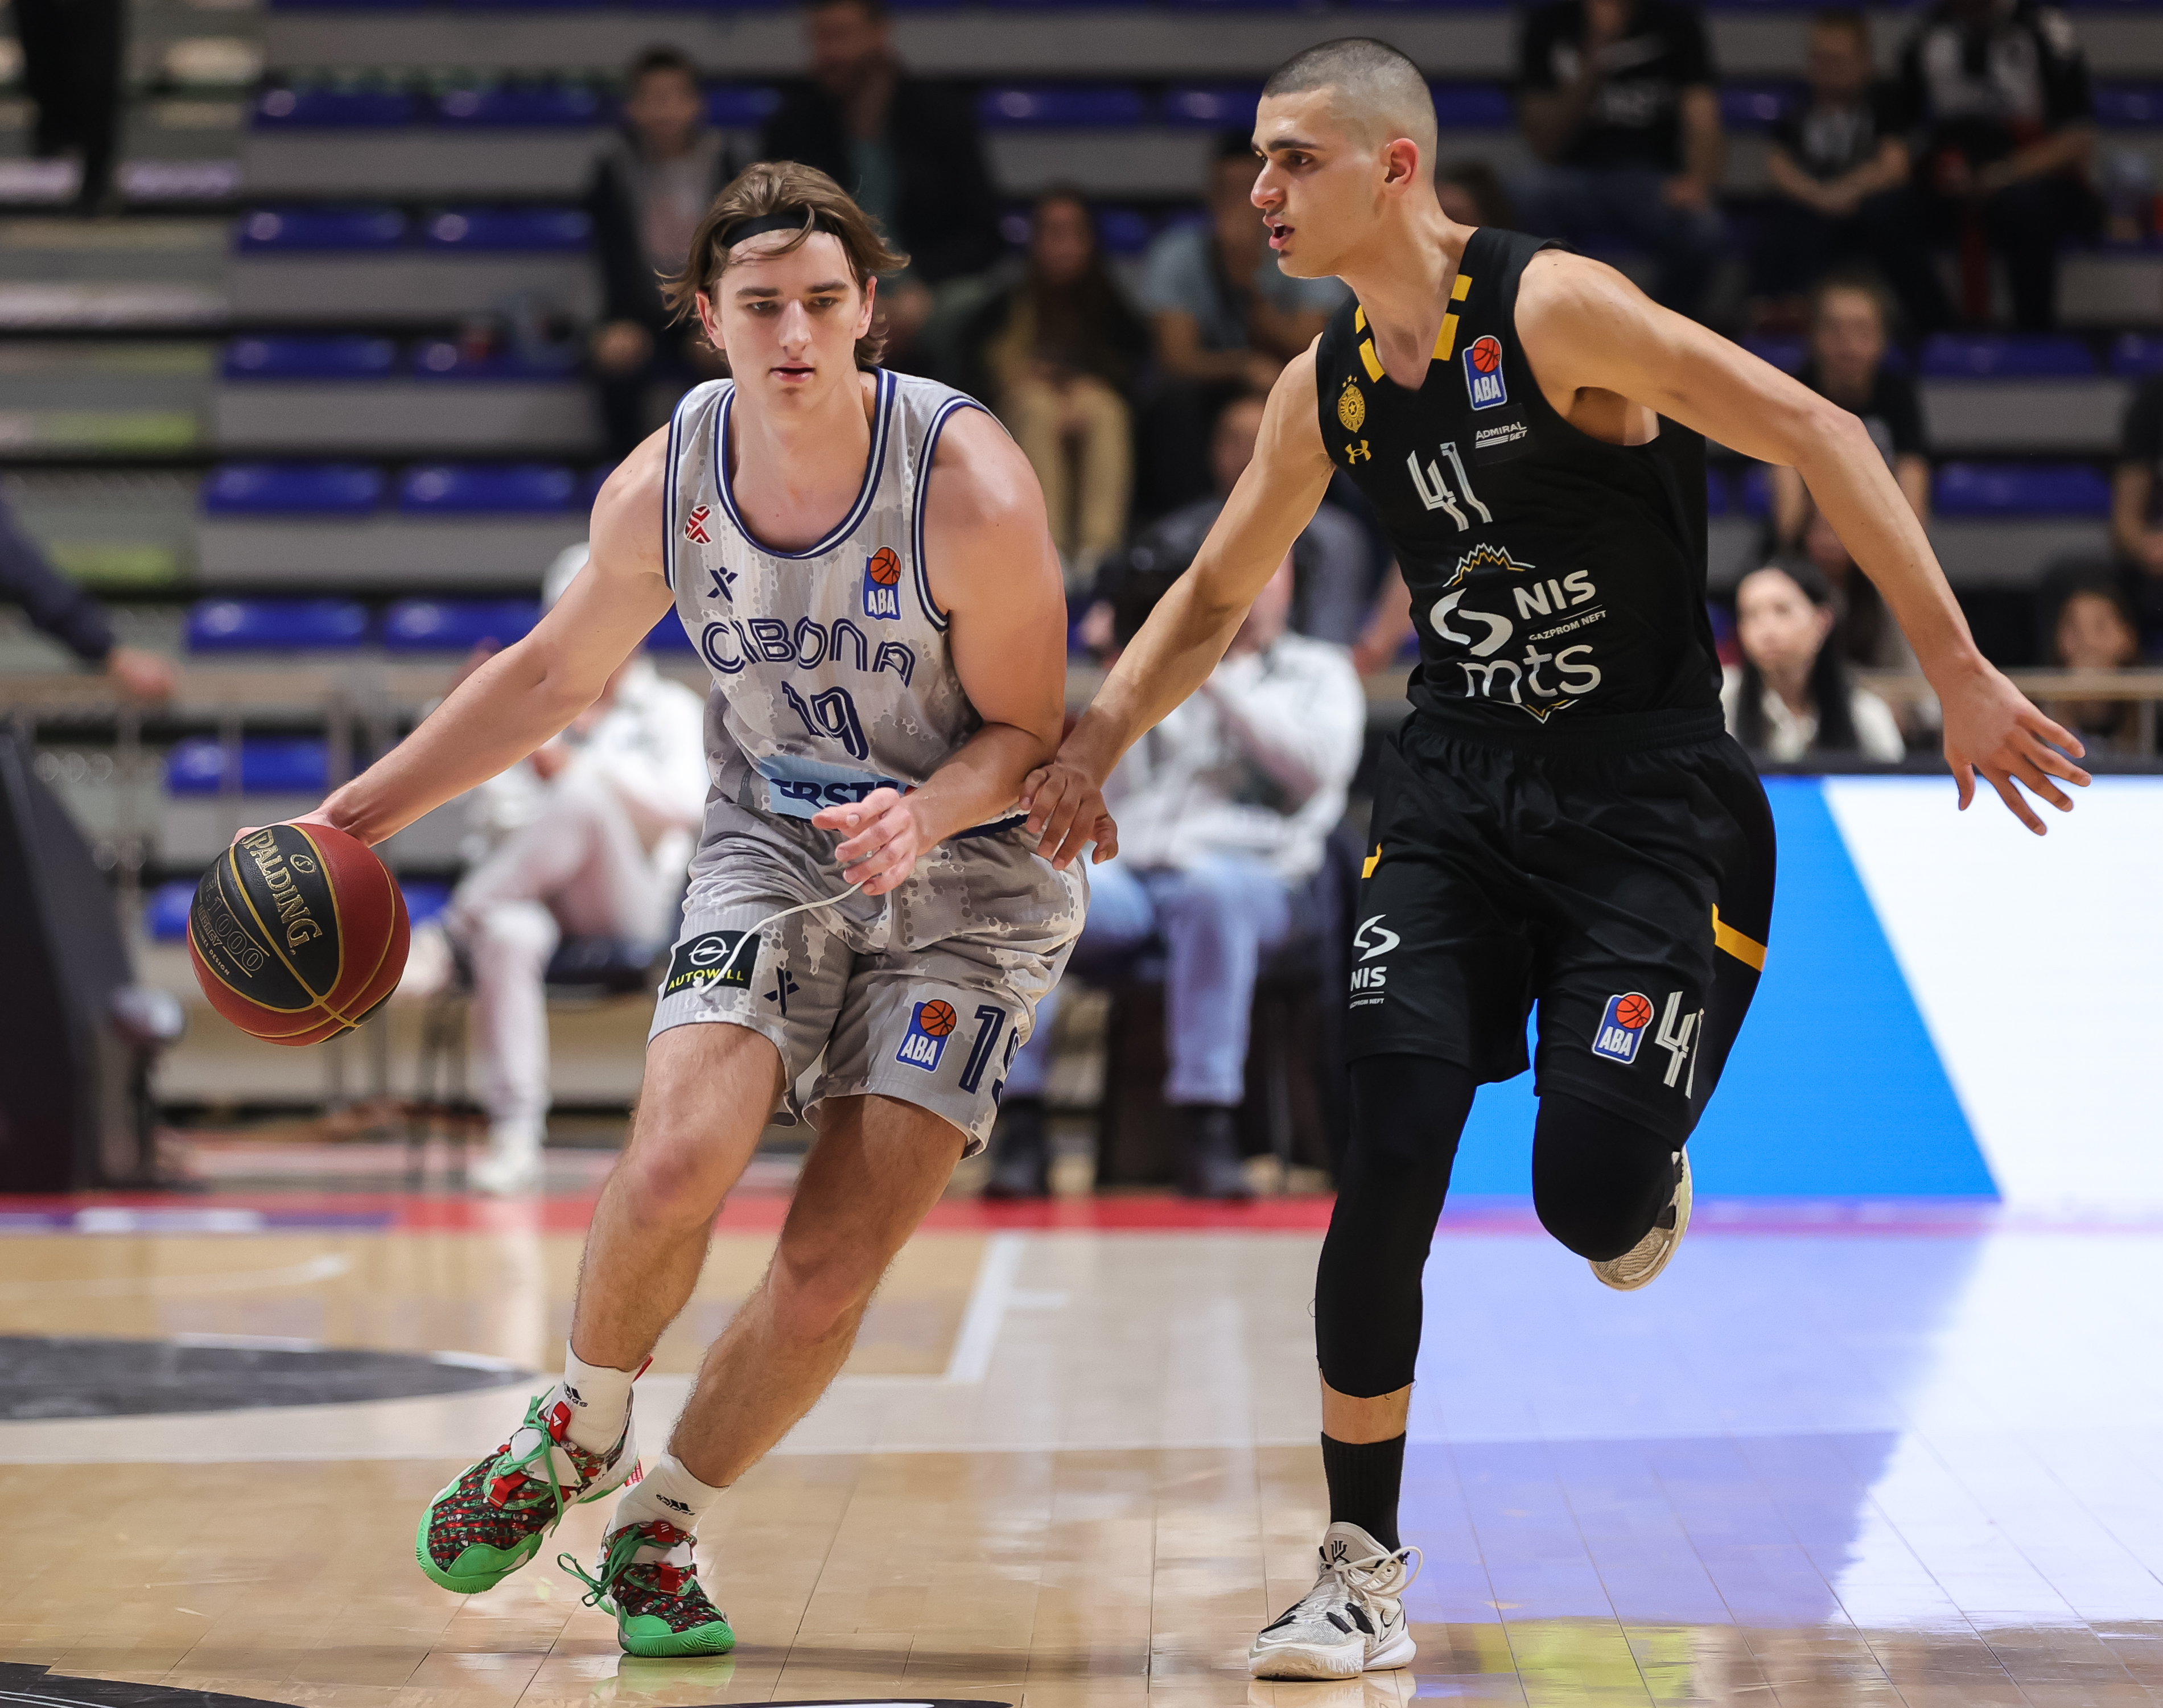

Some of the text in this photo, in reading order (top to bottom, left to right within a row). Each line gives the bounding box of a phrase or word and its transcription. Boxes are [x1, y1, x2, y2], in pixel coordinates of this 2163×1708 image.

[1473, 375, 1502, 403] ABA
[1476, 421, 1527, 441] ADMIRAL
[1509, 430, 1528, 441] BET
[1407, 442, 1493, 532] 41
[868, 588, 897, 615] ABA
[1513, 570, 1596, 620] NIS
[1528, 610, 1606, 640] GAZPROM NEFT
[702, 616, 916, 689] CIBONA
[781, 681, 869, 761] 19
[770, 778, 899, 809] ERST
[197, 904, 223, 946] LEGACY
[209, 949, 230, 976] DESIGN
[667, 968, 744, 991] AUTOWLL
[1350, 966, 1387, 991] NIS
[900, 1033, 938, 1066] ABA
[1598, 1026, 1634, 1057] ABA
